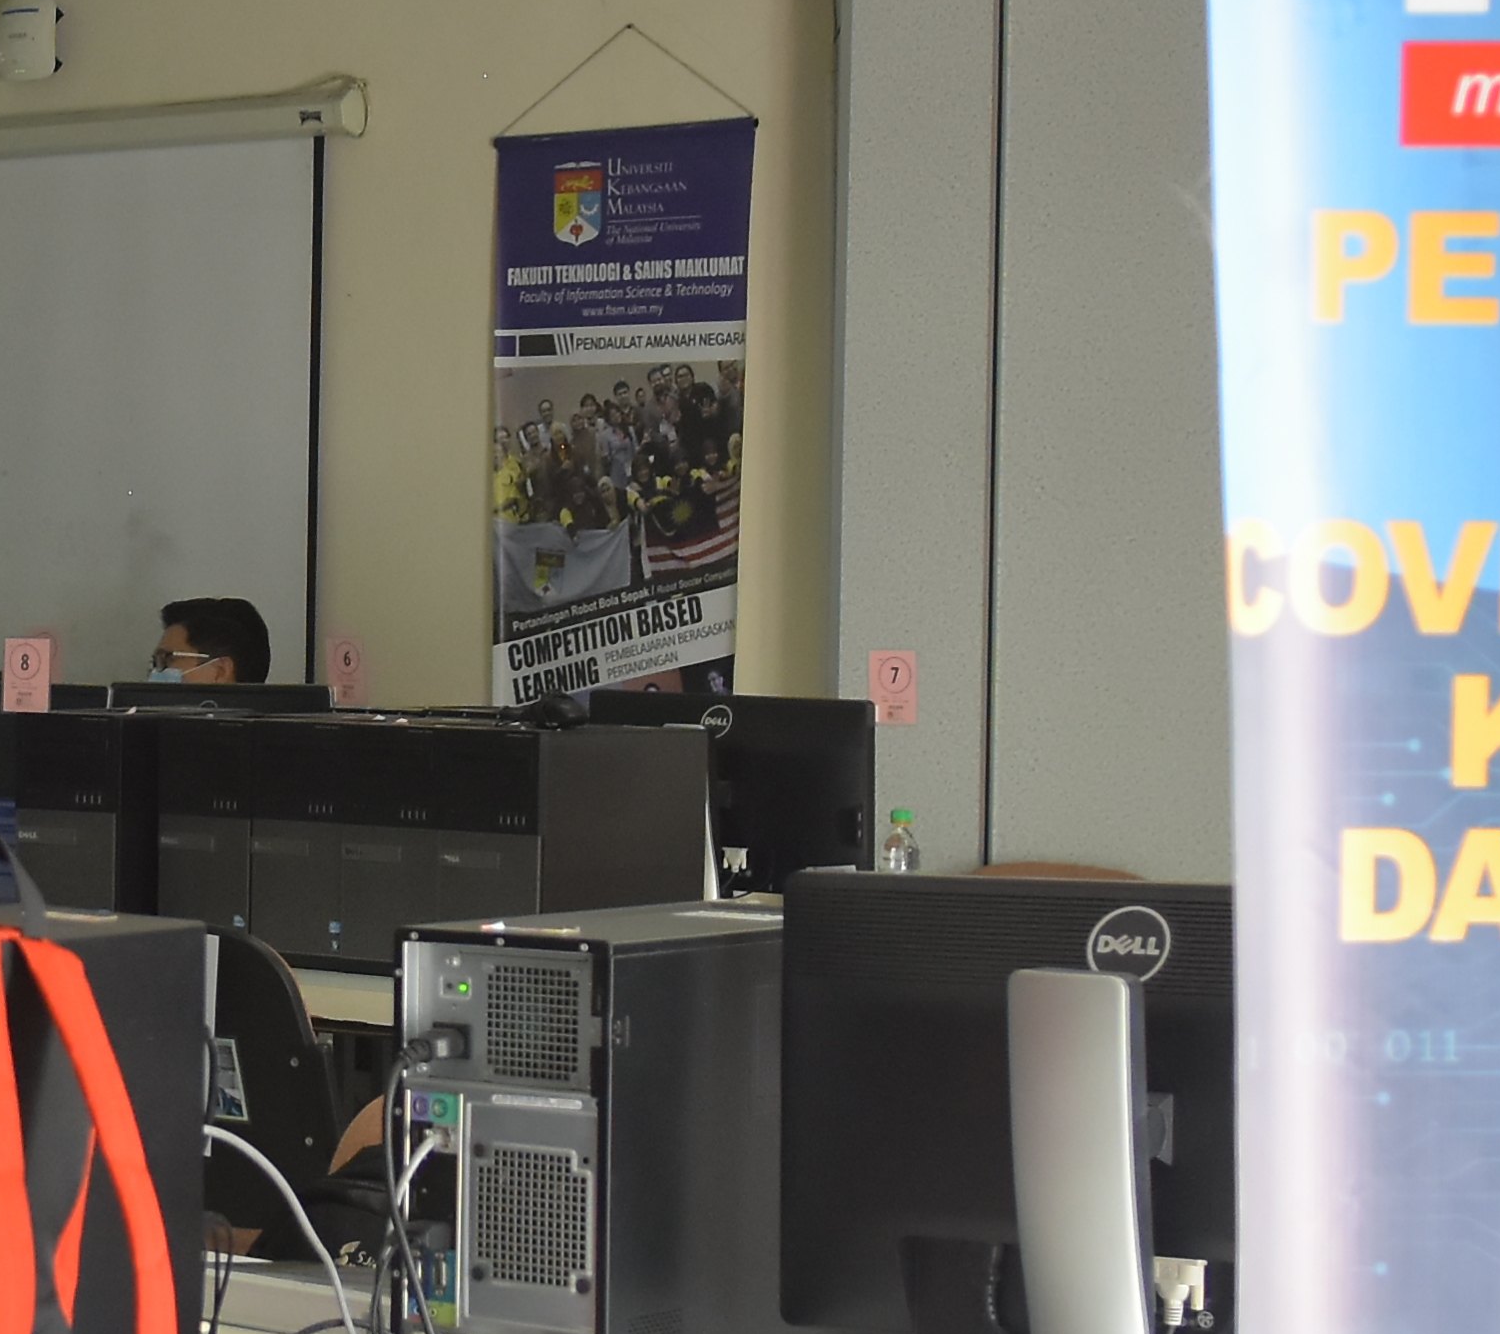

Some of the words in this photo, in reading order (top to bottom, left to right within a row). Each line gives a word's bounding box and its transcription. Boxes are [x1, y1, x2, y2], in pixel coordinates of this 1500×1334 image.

[607, 158, 673, 176] UNIVERSITI
[607, 178, 687, 196] KEBANGSAAN
[606, 197, 664, 215] MALAYSIA
[507, 265, 553, 286] FAKULTI
[555, 262, 621, 284] TEKNOLOGI
[622, 264, 632, 281] &
[634, 260, 672, 280] SAINS
[674, 256, 746, 278] MAKLUMAT
[519, 289, 552, 304] Faculty
[553, 288, 565, 304] of
[566, 286, 623, 303] Information
[625, 284, 663, 299] Science
[664, 284, 673, 297] &
[675, 282, 734, 298] Technology
[575, 335, 643, 351] PENDAULAT
[645, 333, 696, 349] AMANAH
[698, 331, 746, 347] NEGARA
[512, 609, 571, 633] Pertandingan
[571, 601, 598, 616] Robot
[599, 595, 620, 609] Bola
[620, 587, 650, 604] Sepak
[507, 611, 632, 672] COMPETITION
[636, 595, 704, 638] BASED
[604, 632, 677, 664] PEMBELAJARAN
[19, 653, 30, 672] 8
[343, 651, 352, 667] 6
[606, 651, 679, 680] PERTANDINGAN
[512, 656, 600, 705] LEARNING
[890, 666, 900, 684] 7
[705, 716, 728, 726] DELL
[1096, 933, 1160, 956] DELL
